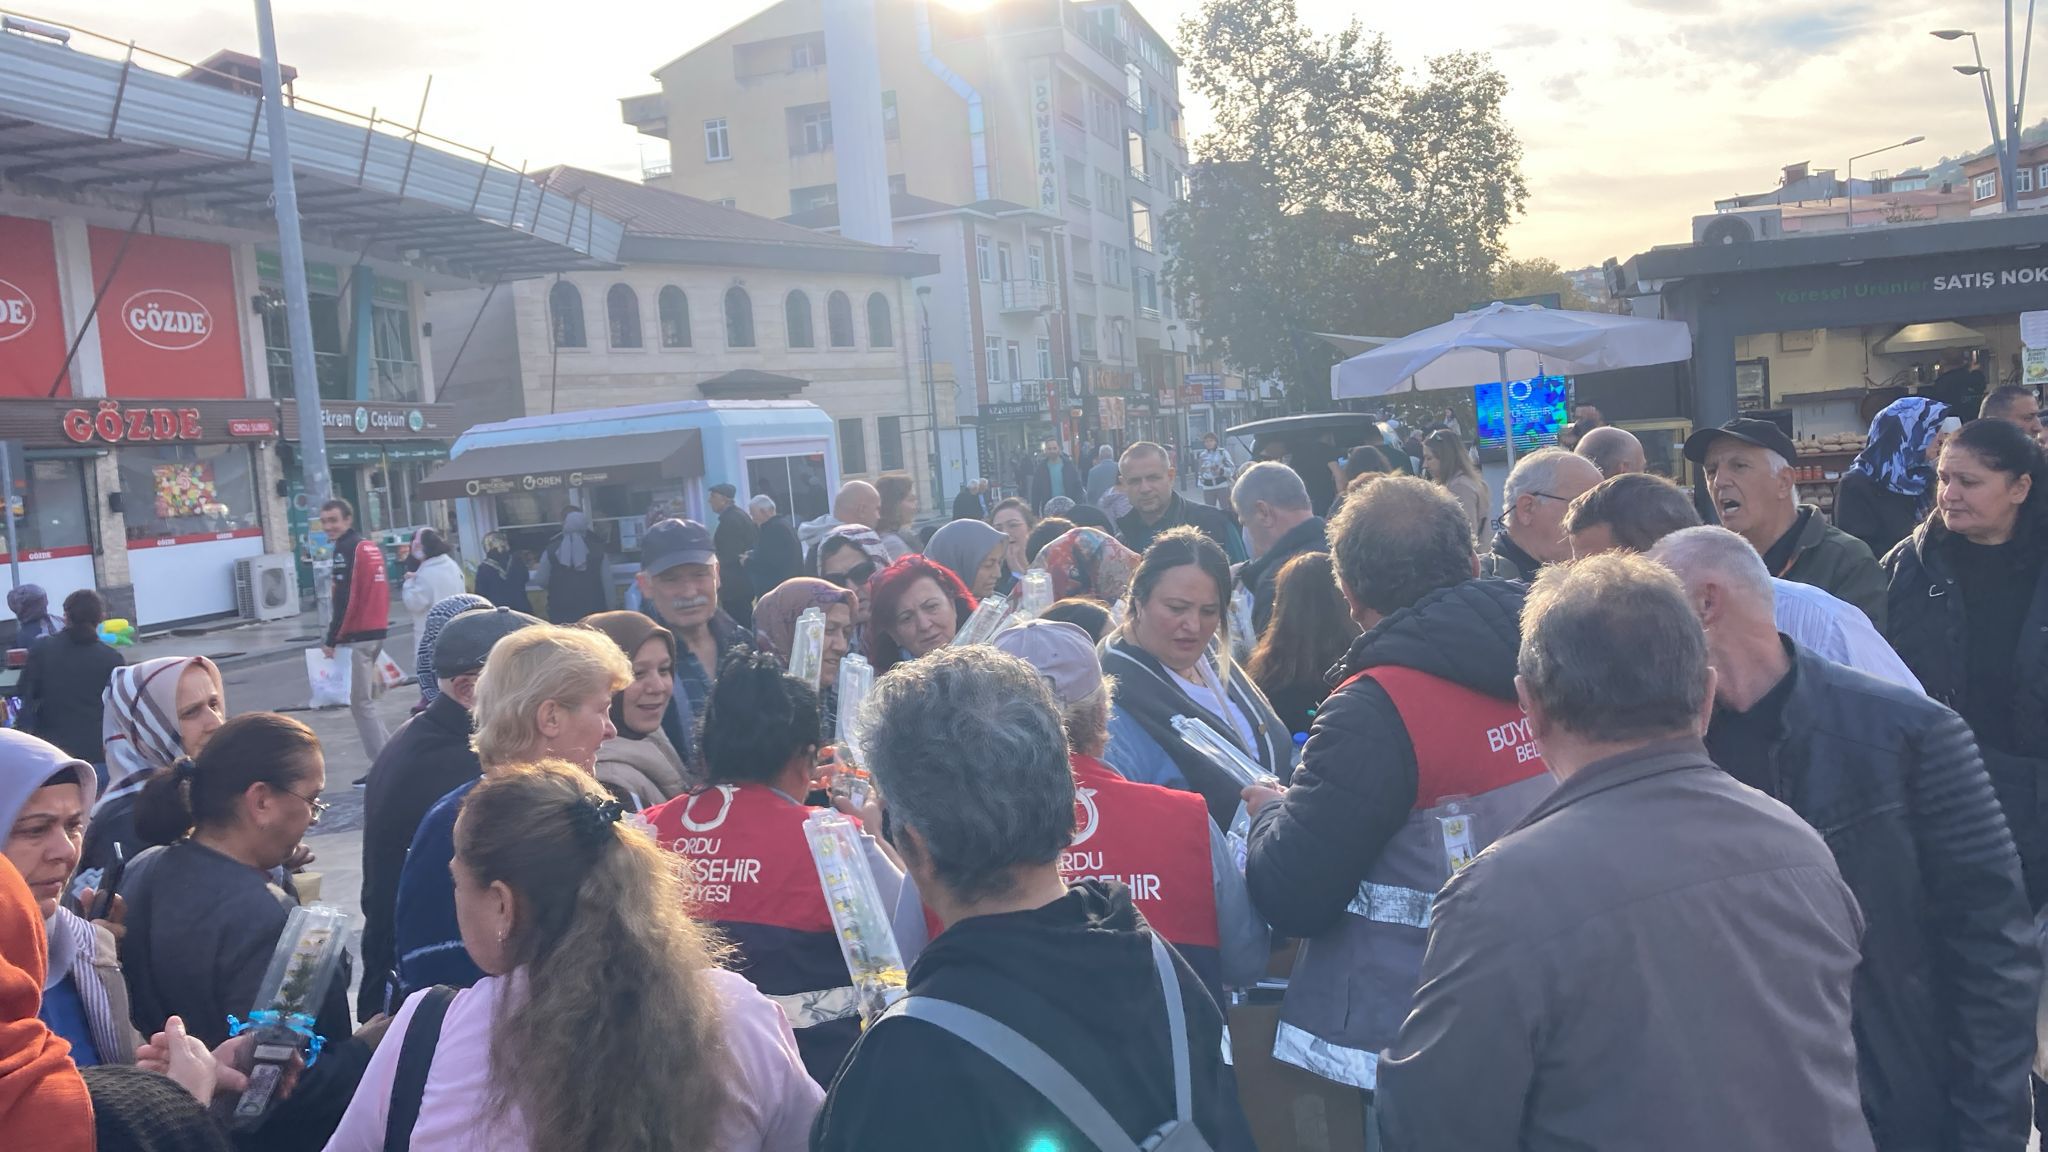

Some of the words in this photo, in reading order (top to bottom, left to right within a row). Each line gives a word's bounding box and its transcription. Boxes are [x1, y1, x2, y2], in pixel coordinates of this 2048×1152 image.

[1933, 270, 1995, 290] SATIŞ
[129, 302, 207, 334] GÖZDE
[63, 400, 202, 443] GÖZDE
[321, 410, 352, 427] Ekrem
[370, 411, 405, 431] Coşkun
[673, 837, 722, 855] ORDU
[1058, 851, 1103, 871] RDU
